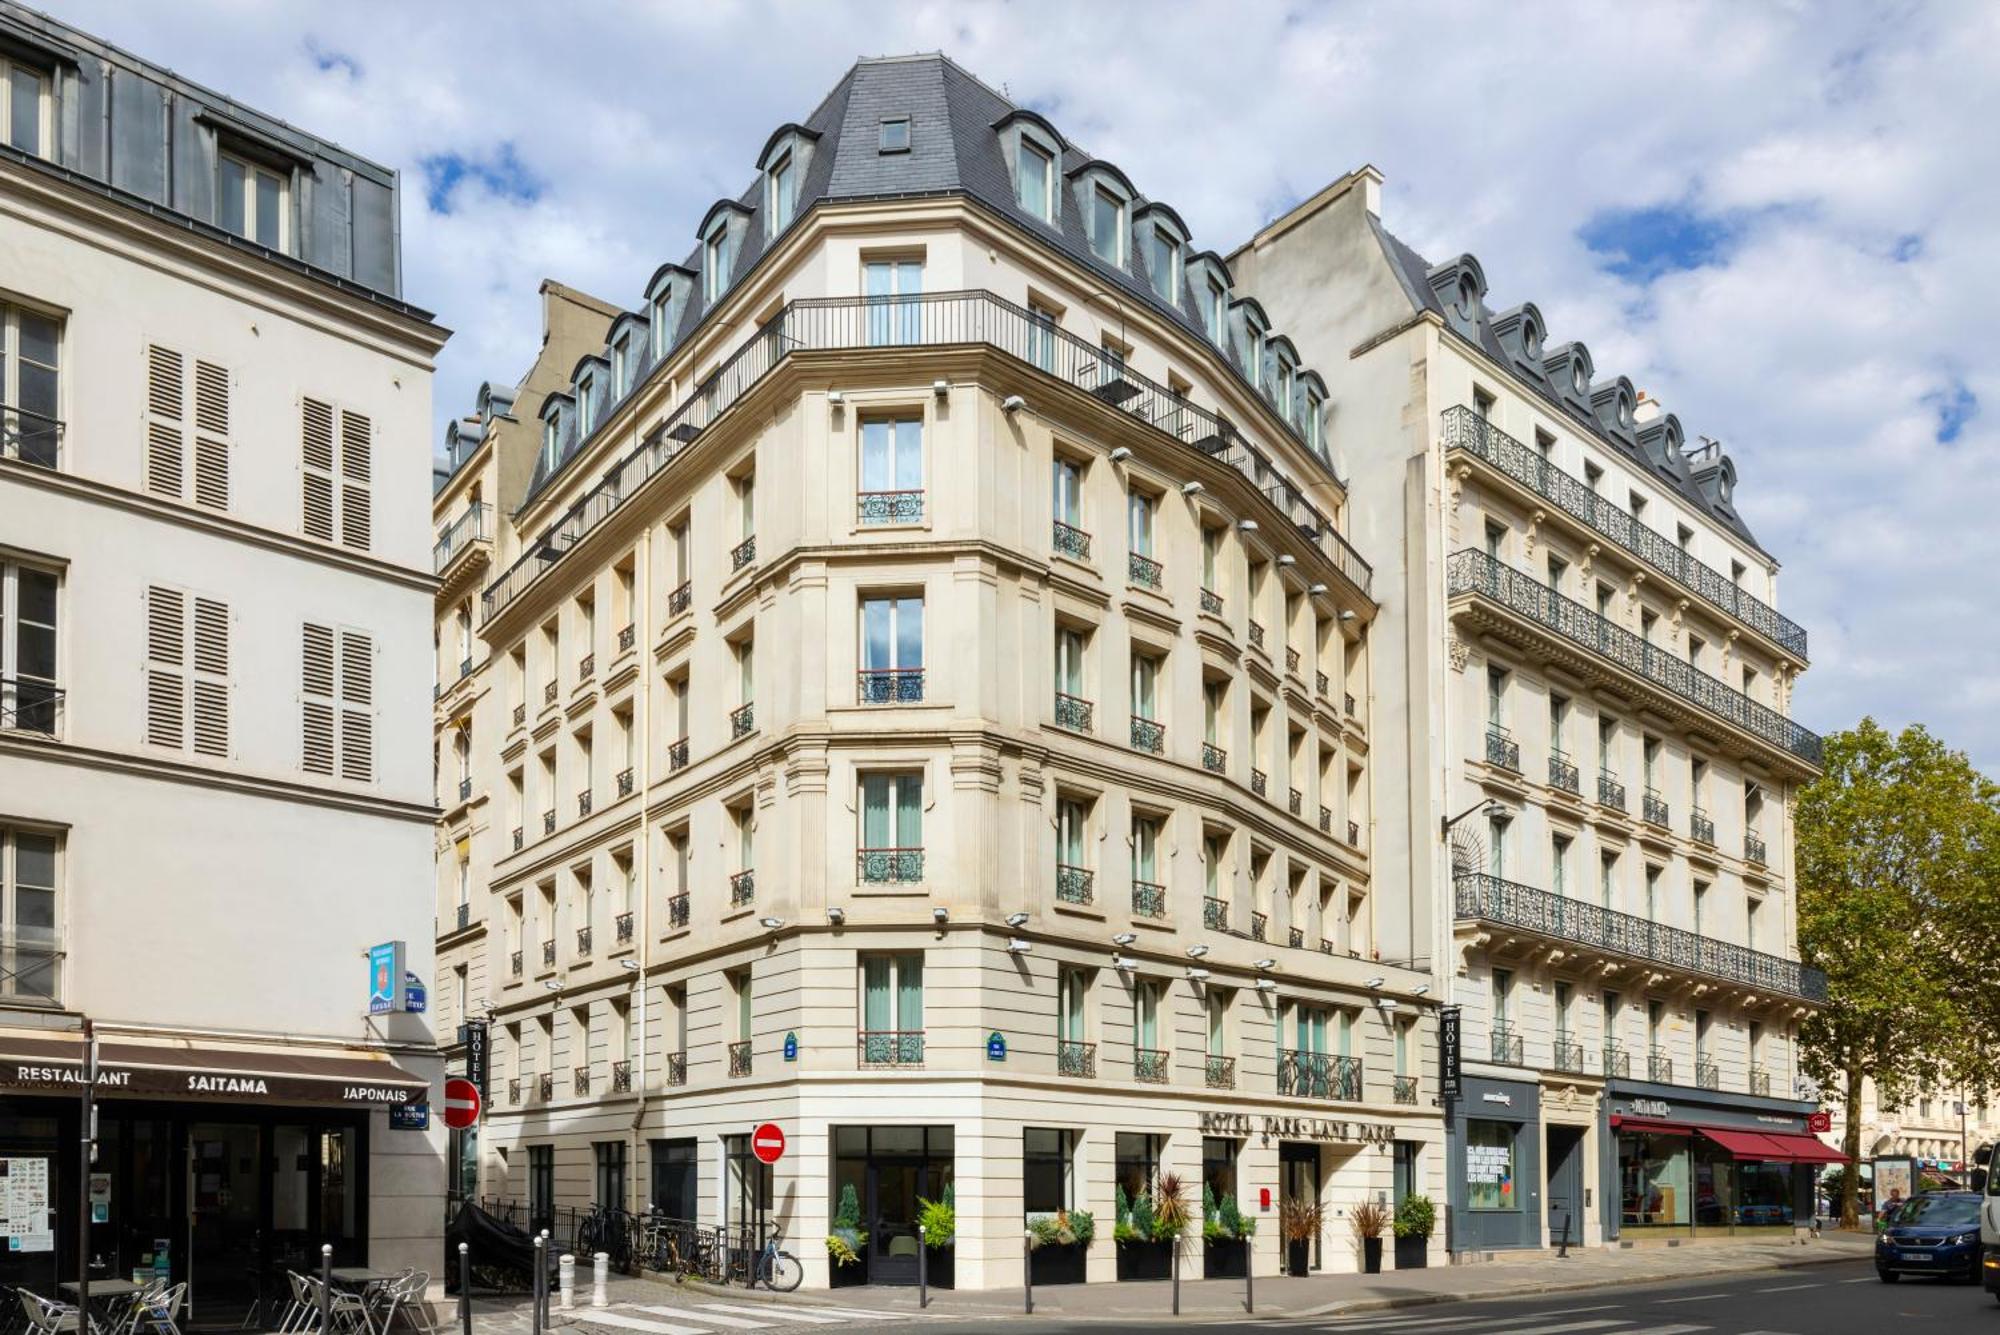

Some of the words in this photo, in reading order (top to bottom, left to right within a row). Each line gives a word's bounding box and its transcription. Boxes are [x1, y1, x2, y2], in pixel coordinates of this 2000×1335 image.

[473, 1031, 481, 1082] HÔTEL
[1446, 1022, 1455, 1077] HÔTEL
[17, 1066, 131, 1085] RESTAUANT
[188, 1075, 268, 1094] SAITAMA
[343, 1087, 408, 1102] JAPONAIS
